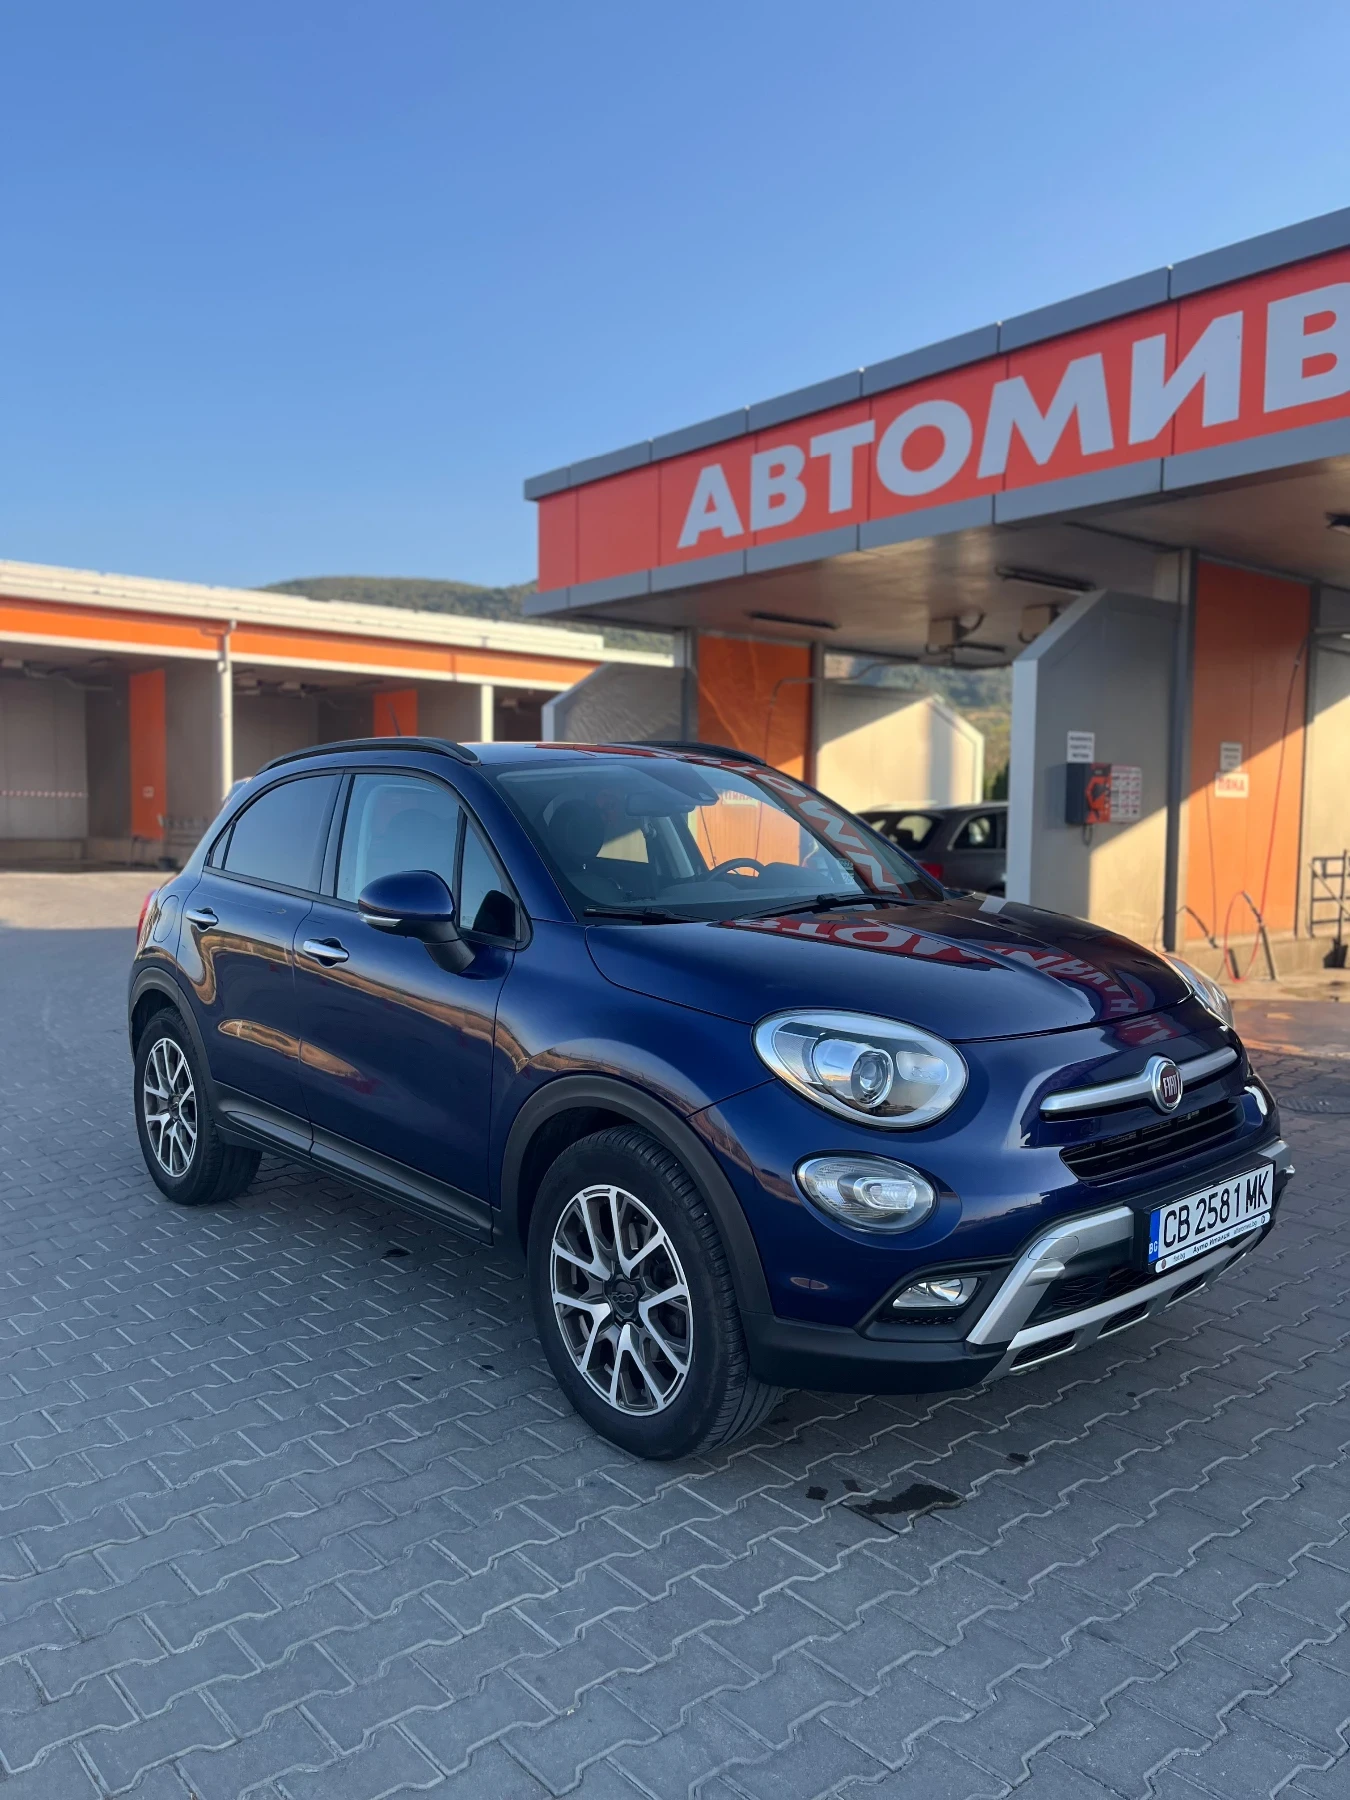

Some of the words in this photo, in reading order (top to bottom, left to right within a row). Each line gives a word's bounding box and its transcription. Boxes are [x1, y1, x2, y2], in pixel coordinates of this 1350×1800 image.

[676, 281, 1350, 549] АВТОМИВ
[1162, 1074, 1178, 1098] FIAT
[1163, 1204, 1191, 1248] CB
[1195, 1183, 1241, 1236] 2581
[1245, 1170, 1269, 1214] MK
[1149, 1241, 1159, 1255] BG
